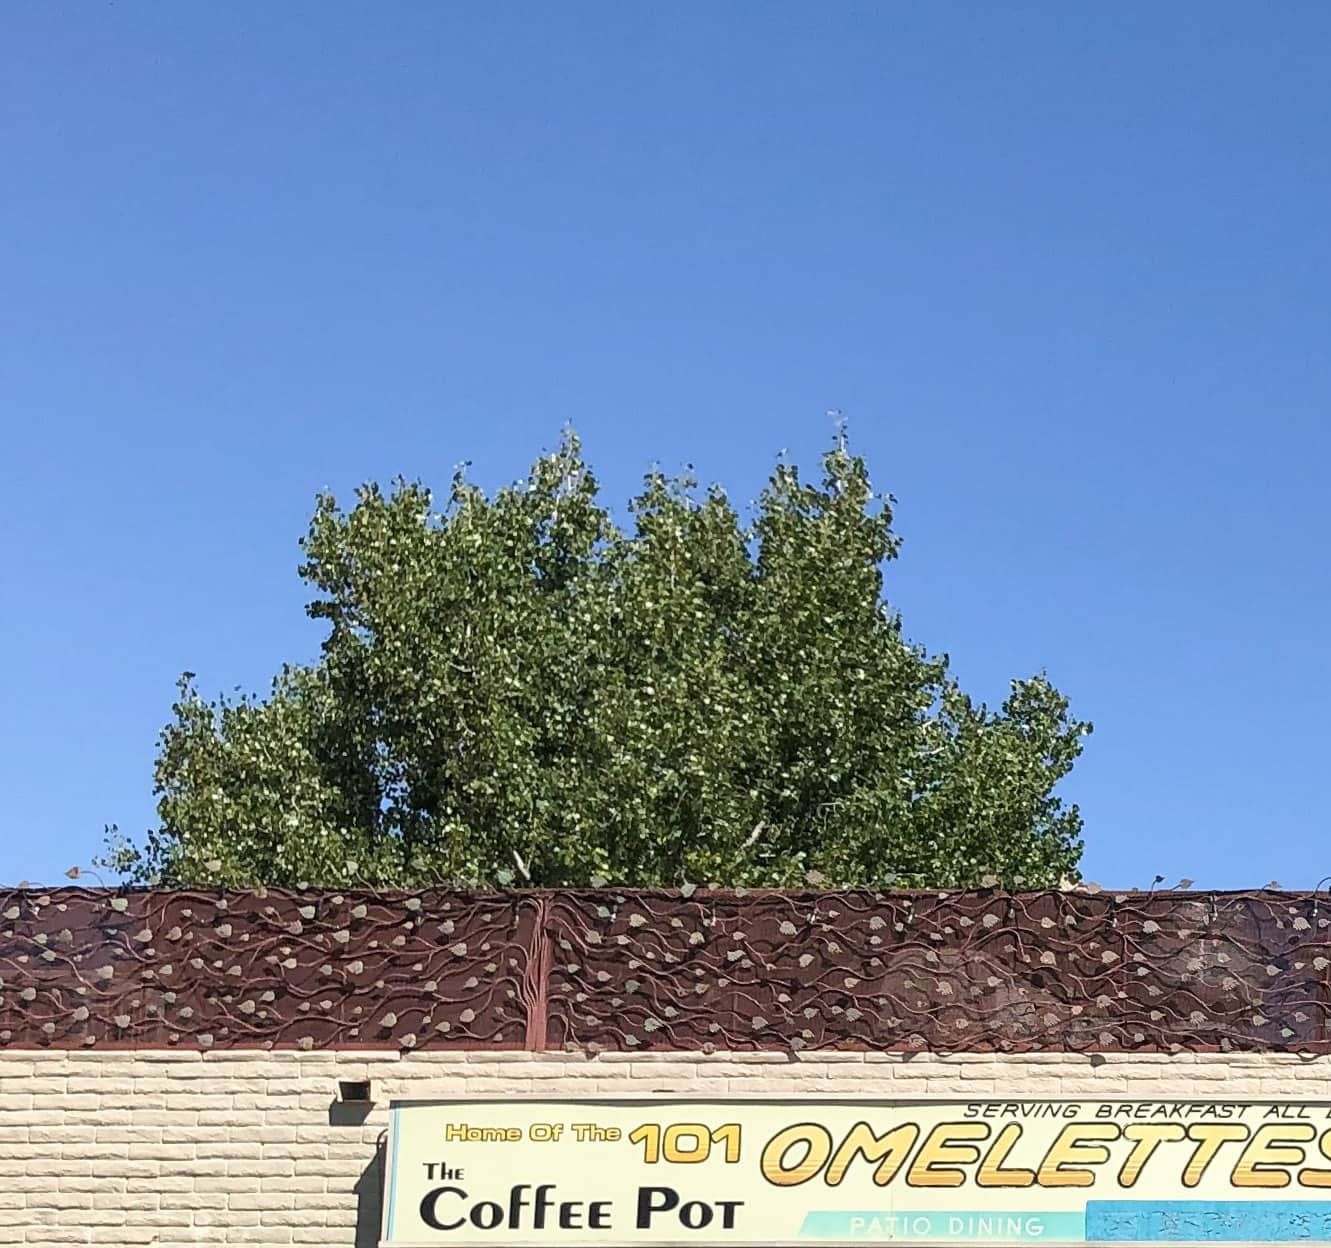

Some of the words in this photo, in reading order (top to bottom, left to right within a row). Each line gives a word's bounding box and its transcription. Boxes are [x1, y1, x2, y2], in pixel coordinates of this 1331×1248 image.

[963, 1103, 1081, 1119] SERVING
[1095, 1103, 1251, 1119] BREAKFAST
[1263, 1103, 1314, 1119] ALL
[445, 1123, 522, 1142] Home
[529, 1123, 564, 1142] Of
[571, 1123, 622, 1142] The
[628, 1123, 742, 1164] 101
[850, 1216, 931, 1236] PATIO
[949, 1216, 1045, 1236] DINING
